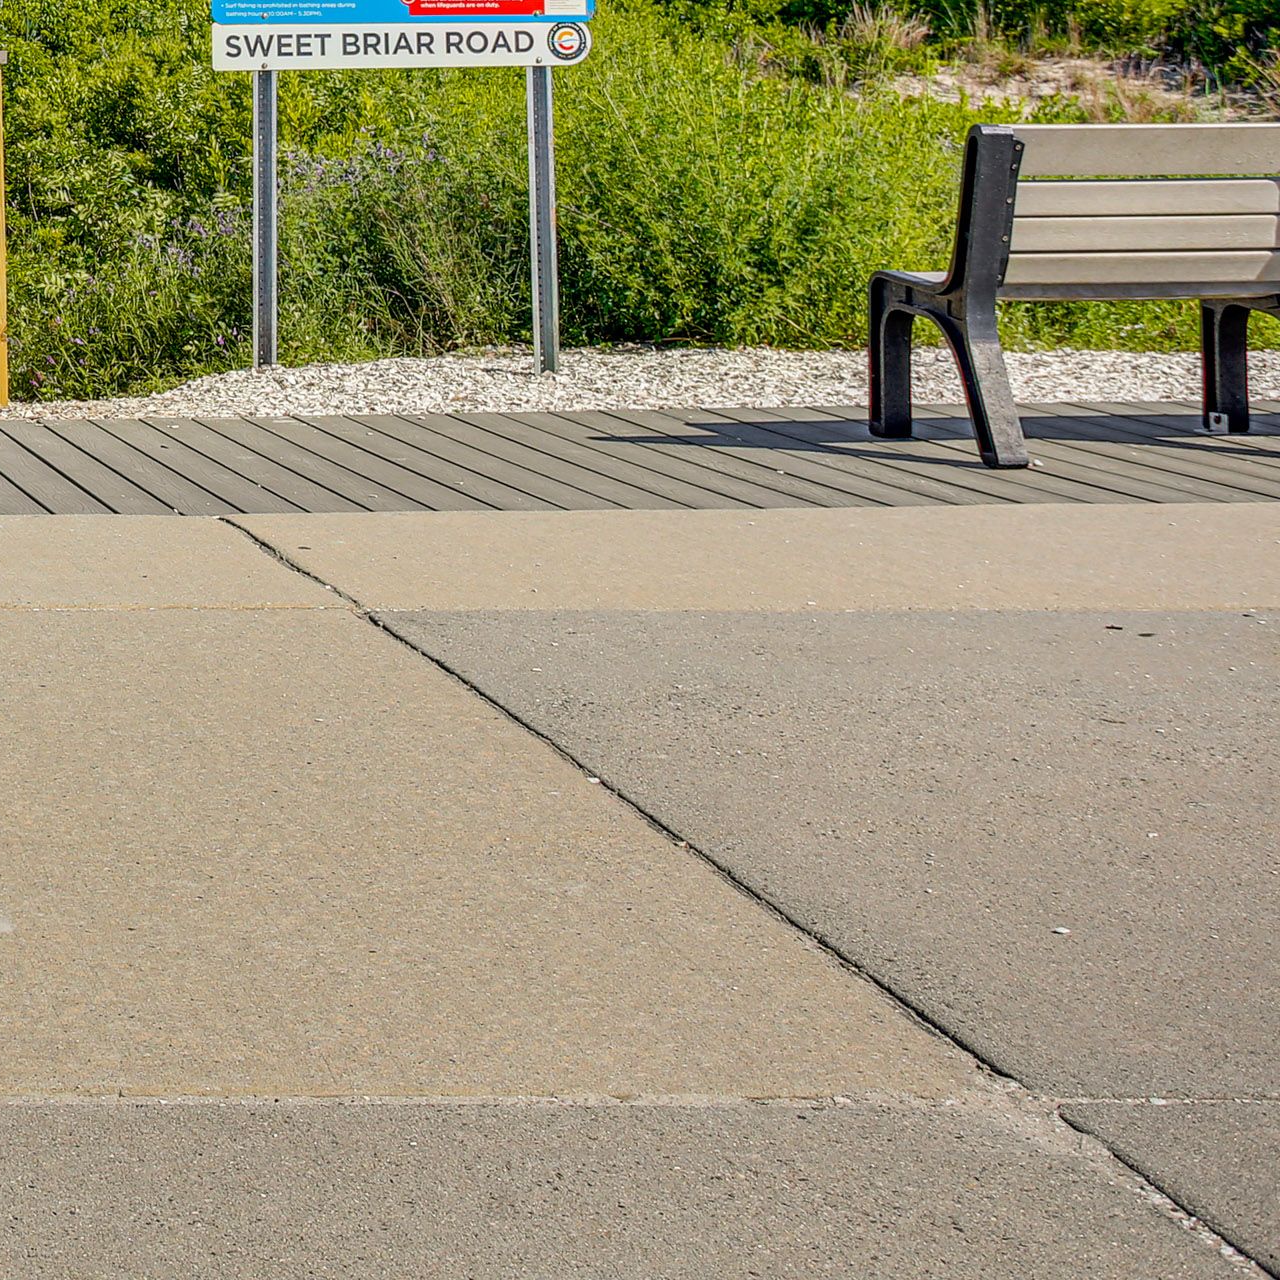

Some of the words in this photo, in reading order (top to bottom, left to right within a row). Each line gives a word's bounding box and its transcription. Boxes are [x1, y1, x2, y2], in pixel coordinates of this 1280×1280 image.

[226, 33, 331, 58] SWEET
[342, 31, 435, 56] BRIAR
[445, 30, 534, 55] ROAD
